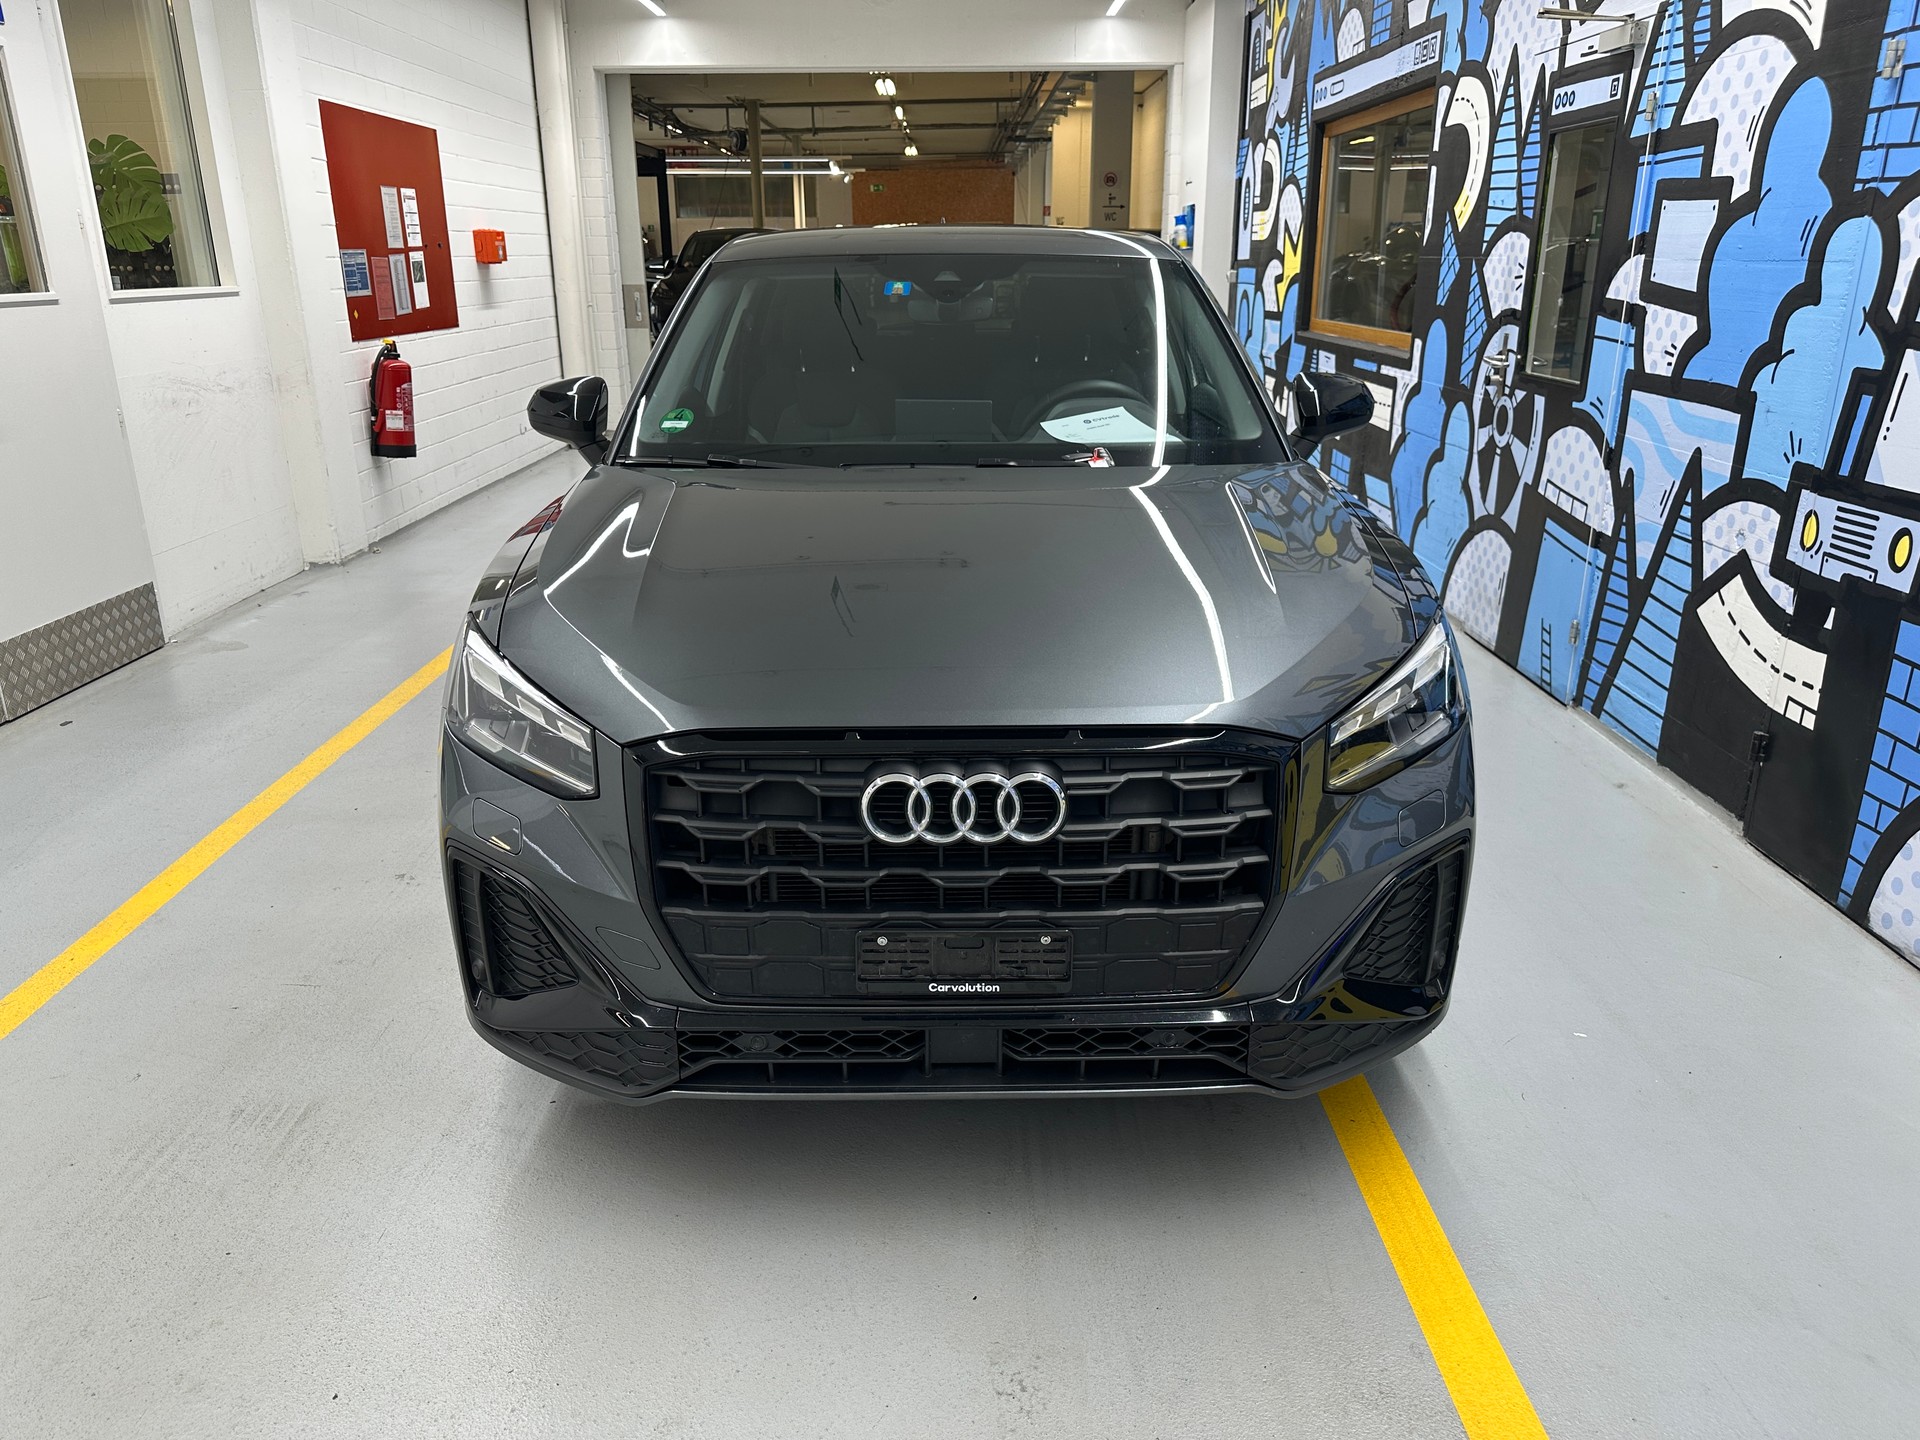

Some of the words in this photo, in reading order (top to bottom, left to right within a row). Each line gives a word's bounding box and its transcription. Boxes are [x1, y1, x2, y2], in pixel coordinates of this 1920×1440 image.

[1104, 211, 1117, 221] WC
[674, 409, 685, 421] 4
[928, 983, 1000, 992] Carvolution
